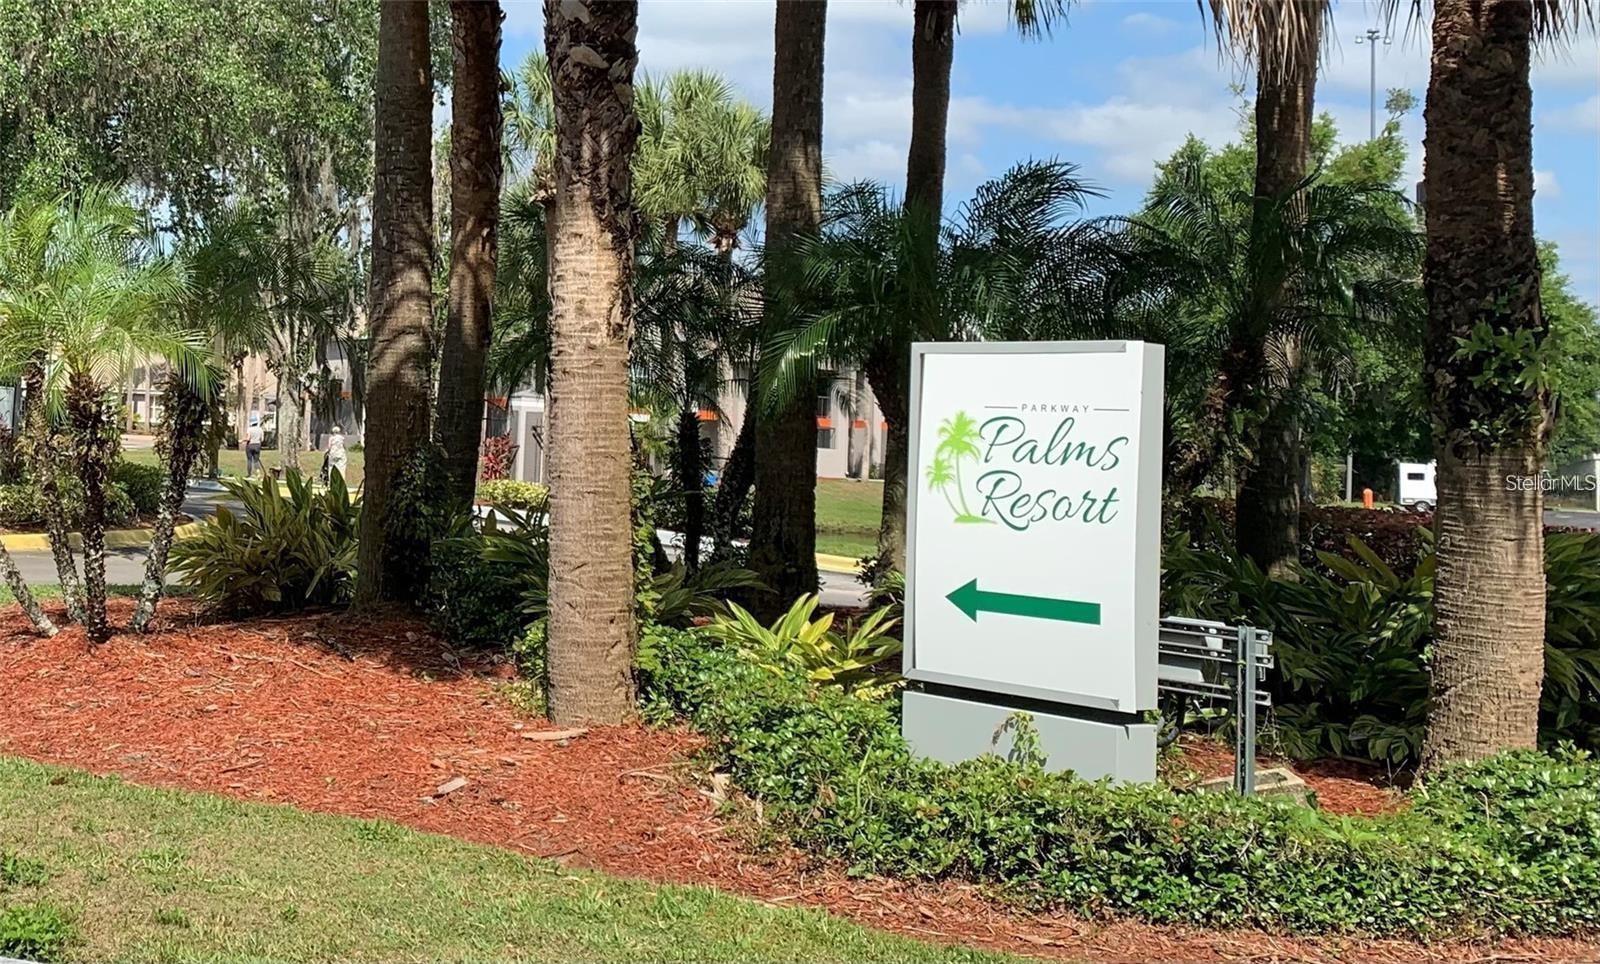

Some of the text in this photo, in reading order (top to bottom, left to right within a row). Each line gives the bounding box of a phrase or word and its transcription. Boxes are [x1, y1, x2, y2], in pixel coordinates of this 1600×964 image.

[1021, 403, 1090, 413] PARKWAY
[979, 416, 1129, 471] Palms
[976, 469, 1120, 531] Resort
